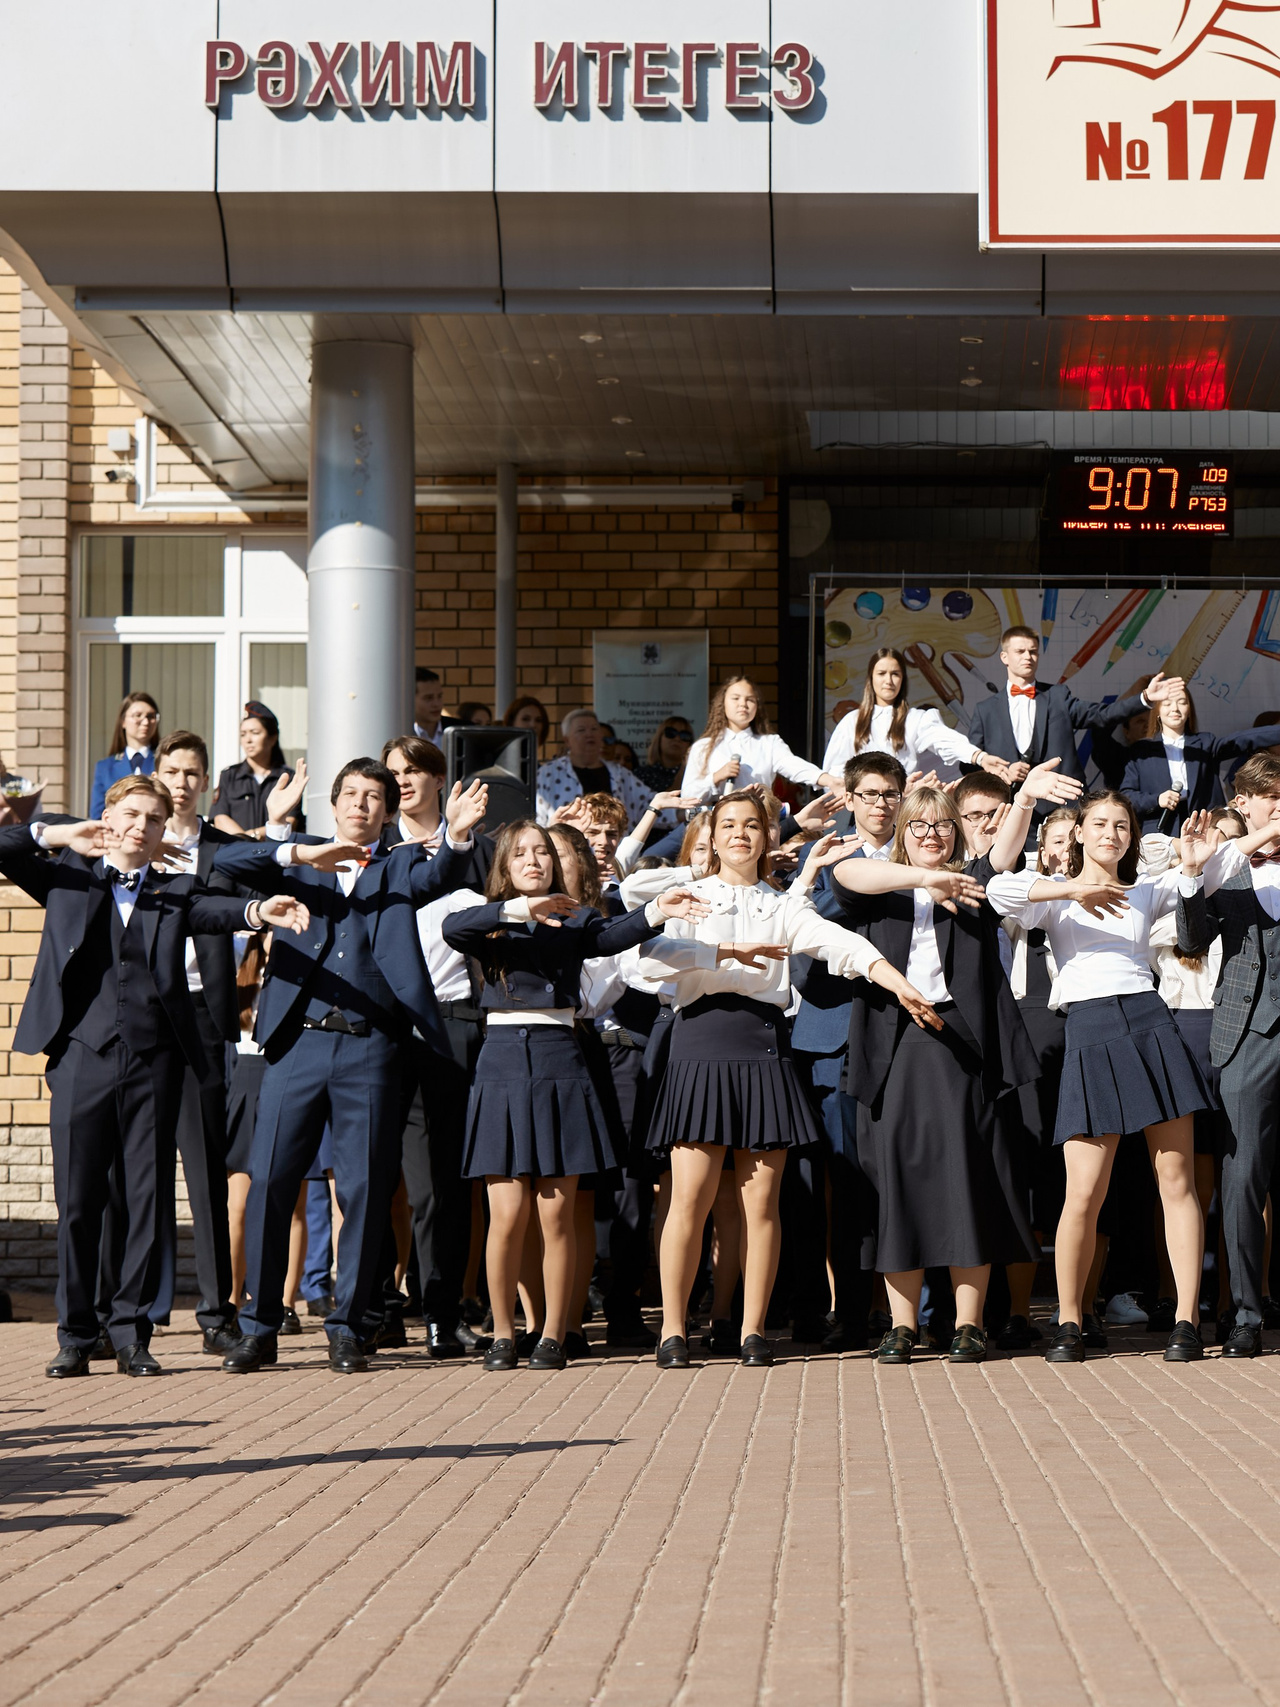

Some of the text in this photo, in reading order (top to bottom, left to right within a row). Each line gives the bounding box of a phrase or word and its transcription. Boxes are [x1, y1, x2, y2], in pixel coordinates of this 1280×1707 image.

[204, 39, 815, 109] РӘХИМ ИТЕГЕЗ
[1085, 99, 1277, 181] №177
[1108, 456, 1164, 464] ТЕМПЕРАТУРА
[1203, 468, 1228, 483] 1.09
[1088, 467, 1179, 511] 9:07
